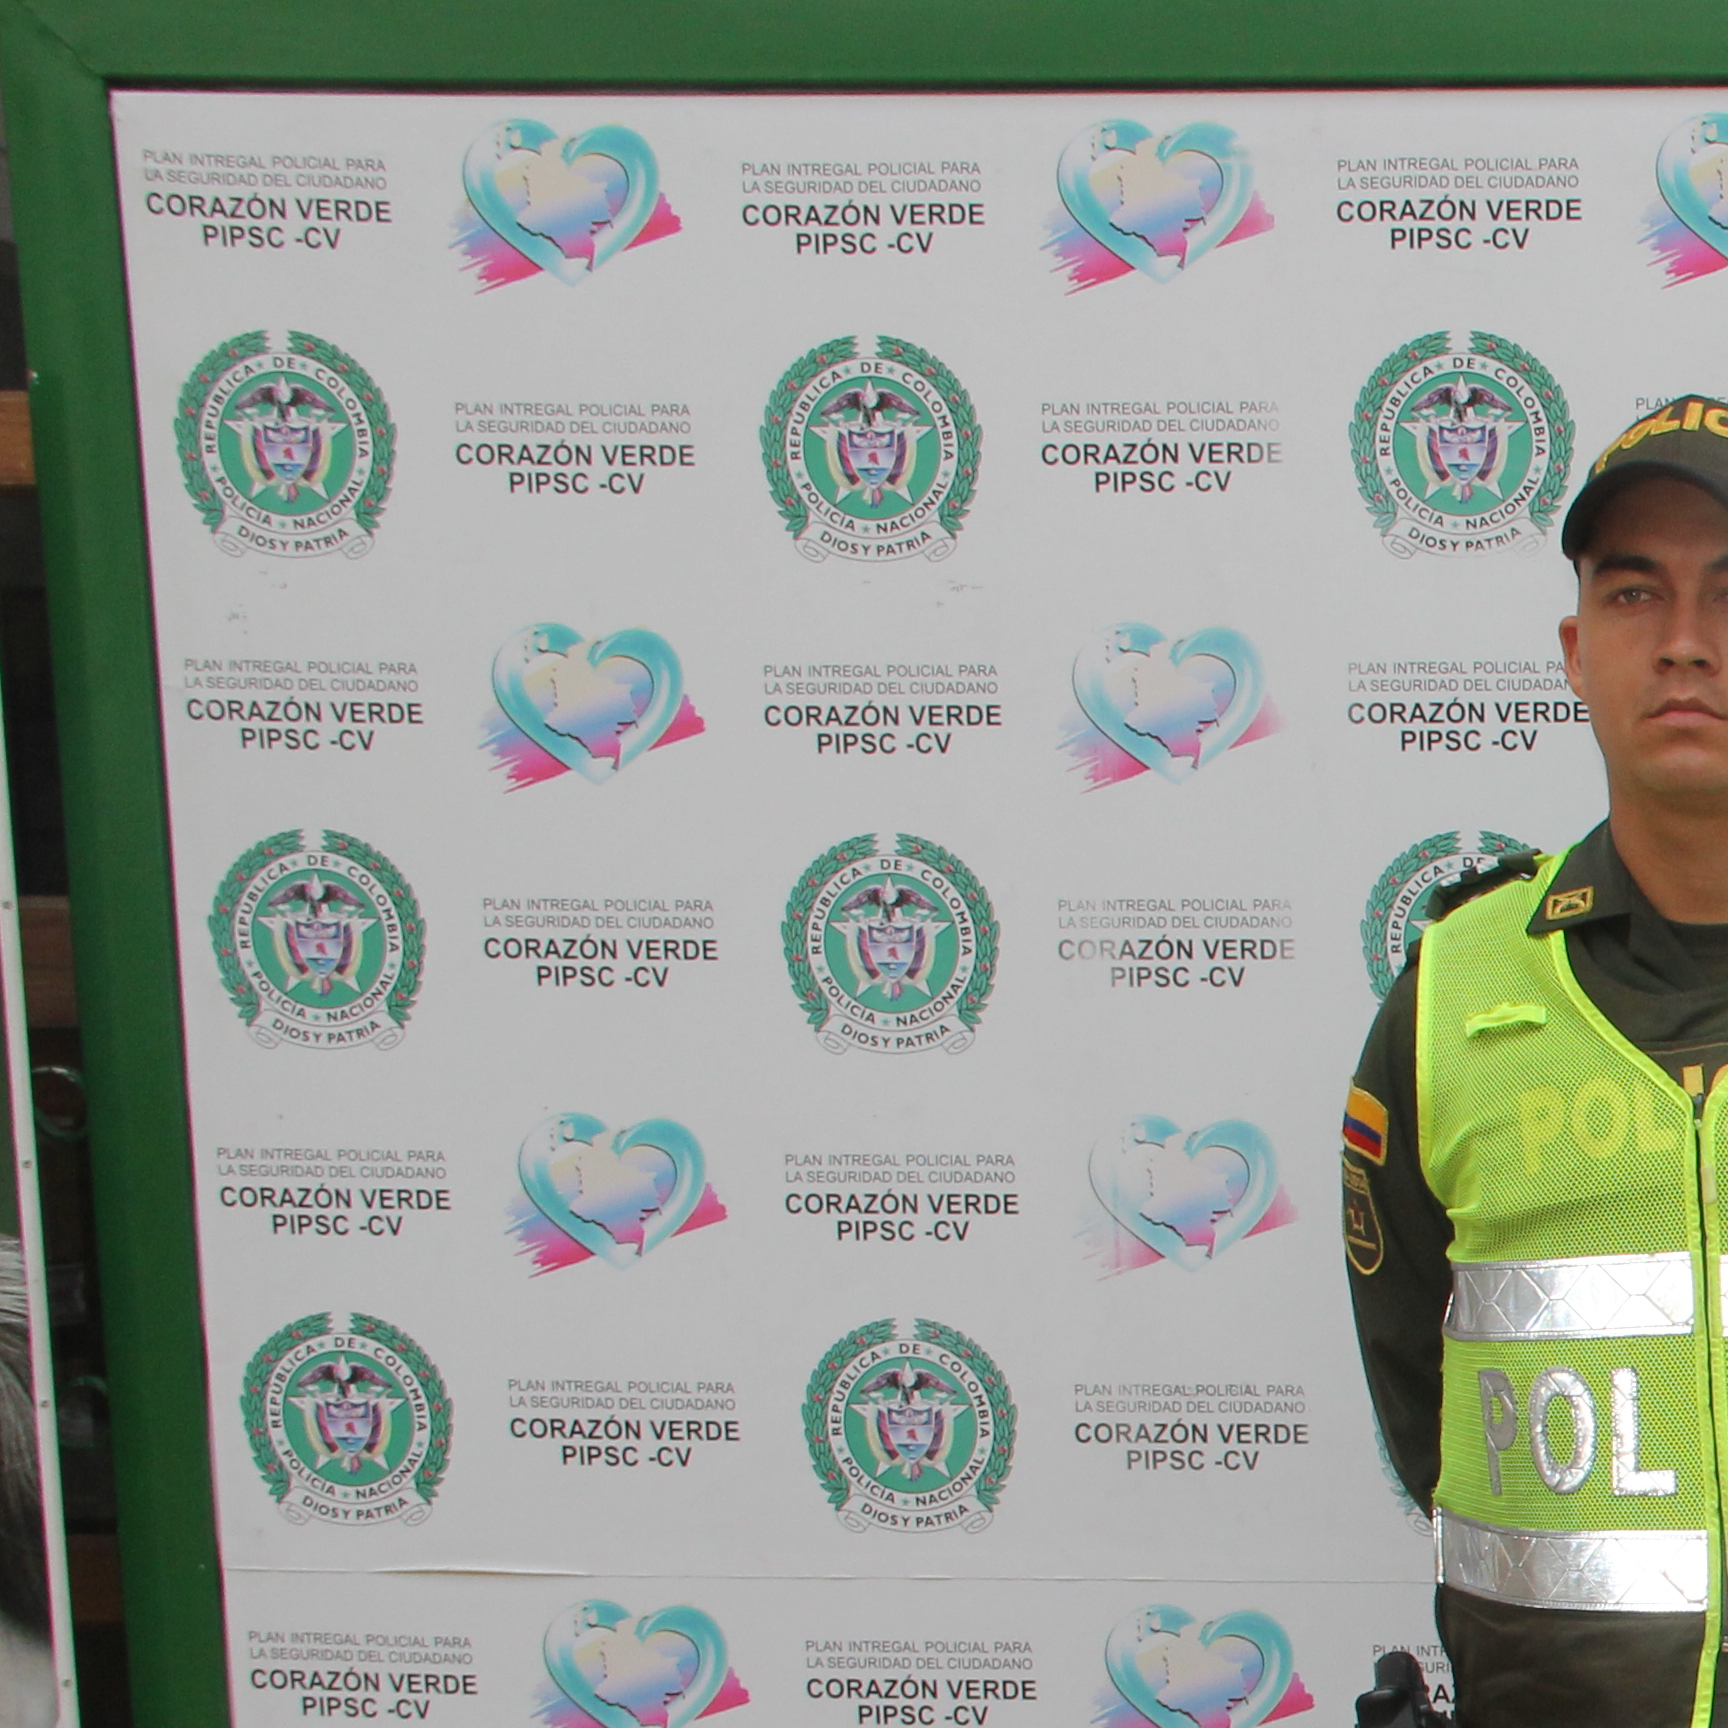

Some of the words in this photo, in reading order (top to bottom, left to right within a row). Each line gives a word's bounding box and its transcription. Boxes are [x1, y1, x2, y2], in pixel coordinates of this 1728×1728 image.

[1337, 159, 1376, 172] PLAN
[1383, 157, 1459, 171] INTREGAL
[1464, 158, 1533, 171] POLICIAL
[1539, 157, 1579, 170] PARA
[1338, 177, 1356, 190] LA
[1360, 175, 1449, 190] SEGURIDAD
[1454, 175, 1483, 188] DEL
[1488, 175, 1579, 189] CIUDADANO
[146, 192, 287, 220] CORAZÓN
[294, 197, 392, 223] VERDE
[1336, 194, 1476, 223] CORAZÓN
[1485, 198, 1582, 221] VERDE
[201, 224, 285, 249] PIPSC
[1390, 227, 1472, 250] PIPSC
[1453, 357, 1476, 370] DE
[1494, 368, 1547, 458] COLOMBIA
[1465, 476, 1540, 530] NACIONAL
[1465, 527, 1522, 552] PATRIA
[216, 1147, 254, 1160] PLAN
[260, 1148, 332, 1161] INTREGAL
[337, 1149, 402, 1162] POLICIAL
[407, 1150, 445, 1162] PARA
[218, 1164, 236, 1176] LA
[239, 1164, 324, 1177] SEGURIDAD
[329, 1166, 356, 1178] DEL
[360, 1166, 446, 1179] CIUDADANO
[218, 1183, 352, 1209] CORAZÓN
[359, 1188, 452, 1210] VERDE
[271, 1214, 350, 1236] PIPSC
[1074, 1418, 1208, 1444] CORAZÓN
[1216, 1423, 1309, 1444] VERDE
[1126, 1450, 1205, 1471] PIPSC
